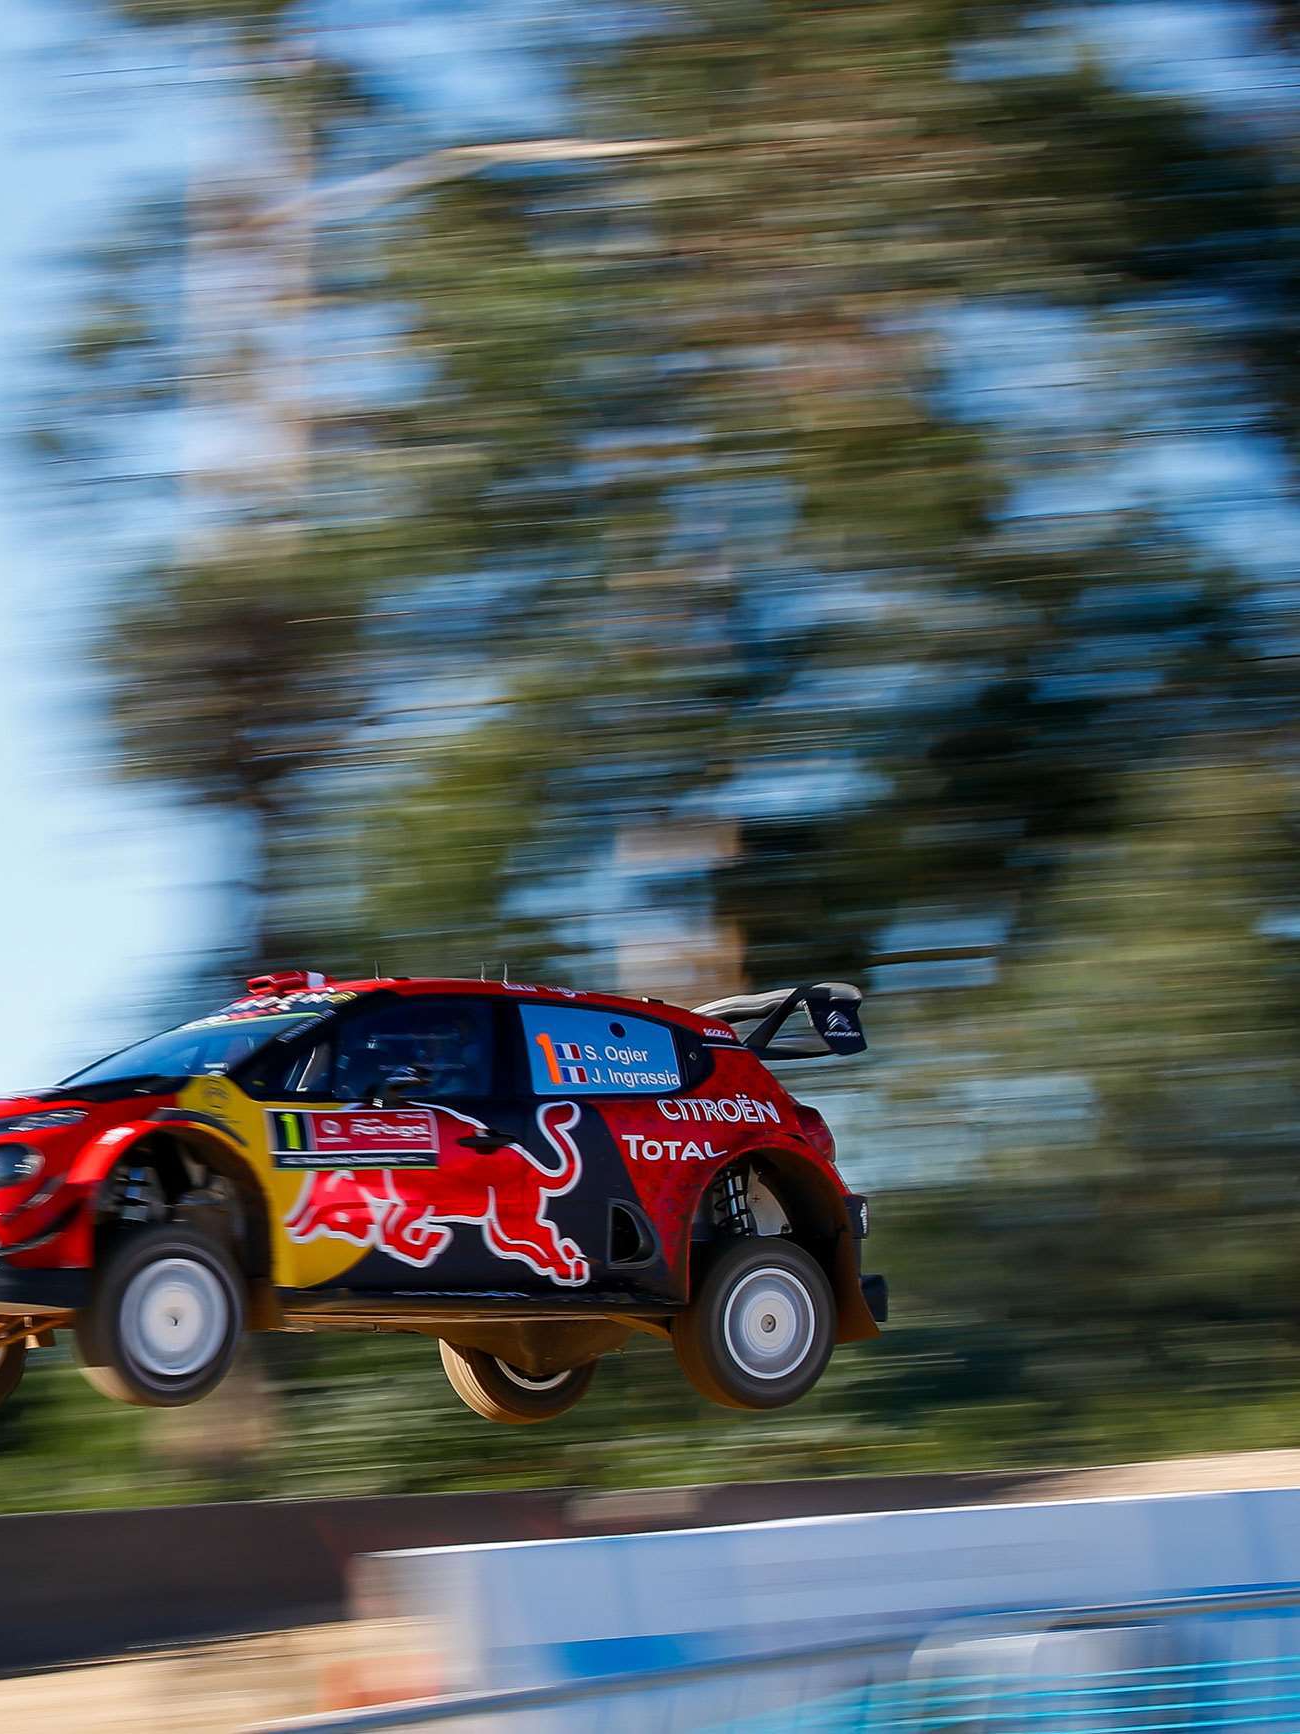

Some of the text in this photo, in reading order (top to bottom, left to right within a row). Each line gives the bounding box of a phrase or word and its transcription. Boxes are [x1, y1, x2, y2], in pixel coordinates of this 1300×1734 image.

[536, 1033, 561, 1084] 1
[585, 1045, 648, 1065] S. Ogier
[591, 1066, 681, 1088] J. Ingrassia
[657, 1093, 781, 1124] CITROËN
[278, 1113, 301, 1150] 1
[621, 1134, 728, 1161] TOTAL
